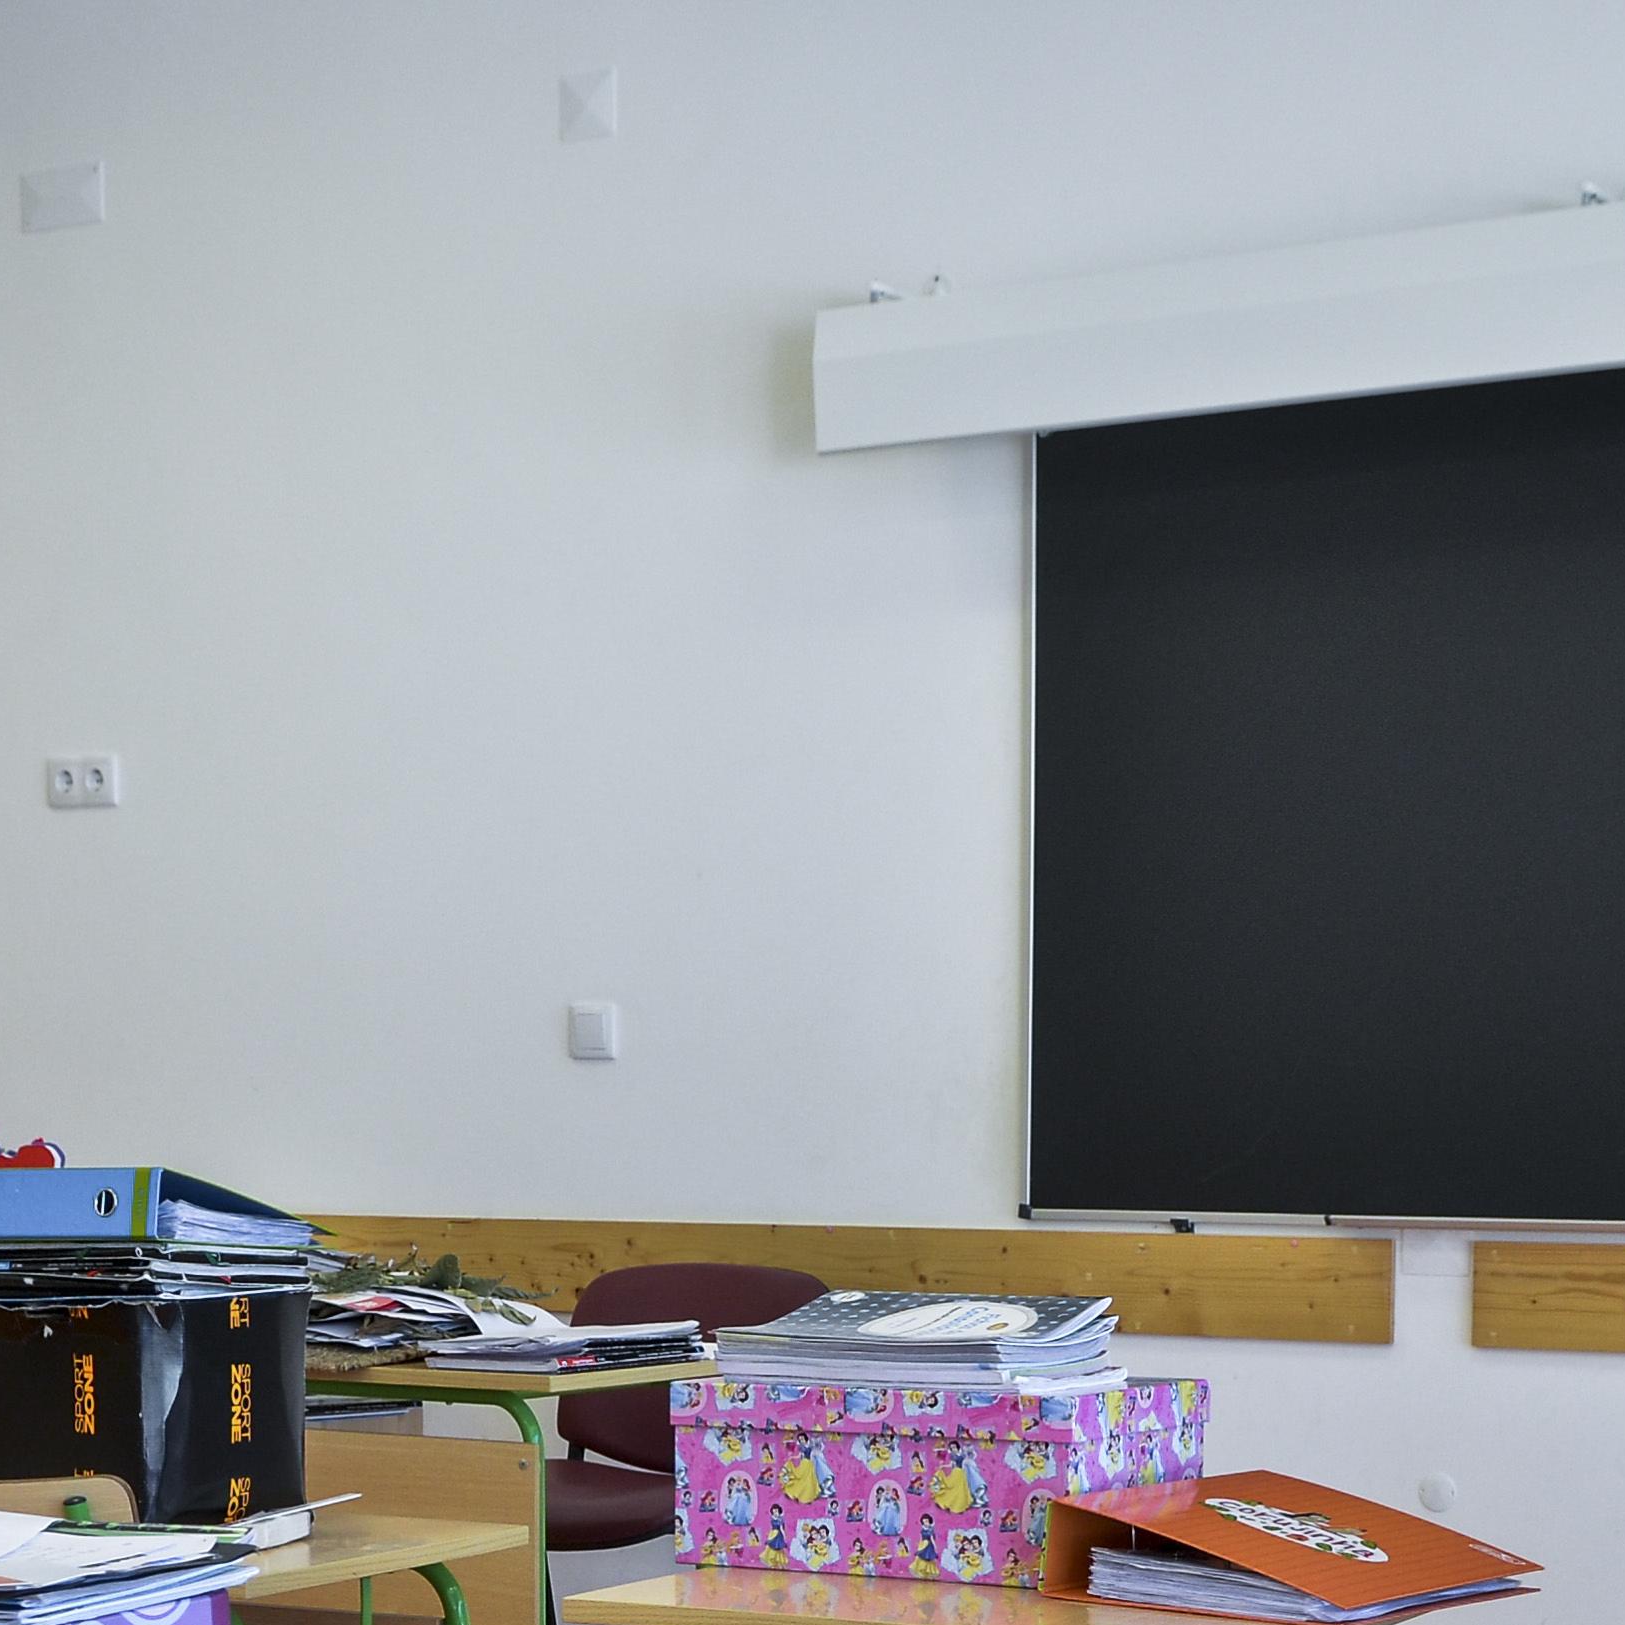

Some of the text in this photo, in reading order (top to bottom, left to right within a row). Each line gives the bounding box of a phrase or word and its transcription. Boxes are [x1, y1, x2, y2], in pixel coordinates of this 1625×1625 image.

[73, 1352, 85, 1434] SPORT
[83, 1354, 95, 1436] ZONE
[231, 1364, 242, 1445] ZONE
[241, 1363, 252, 1443] SPORT
